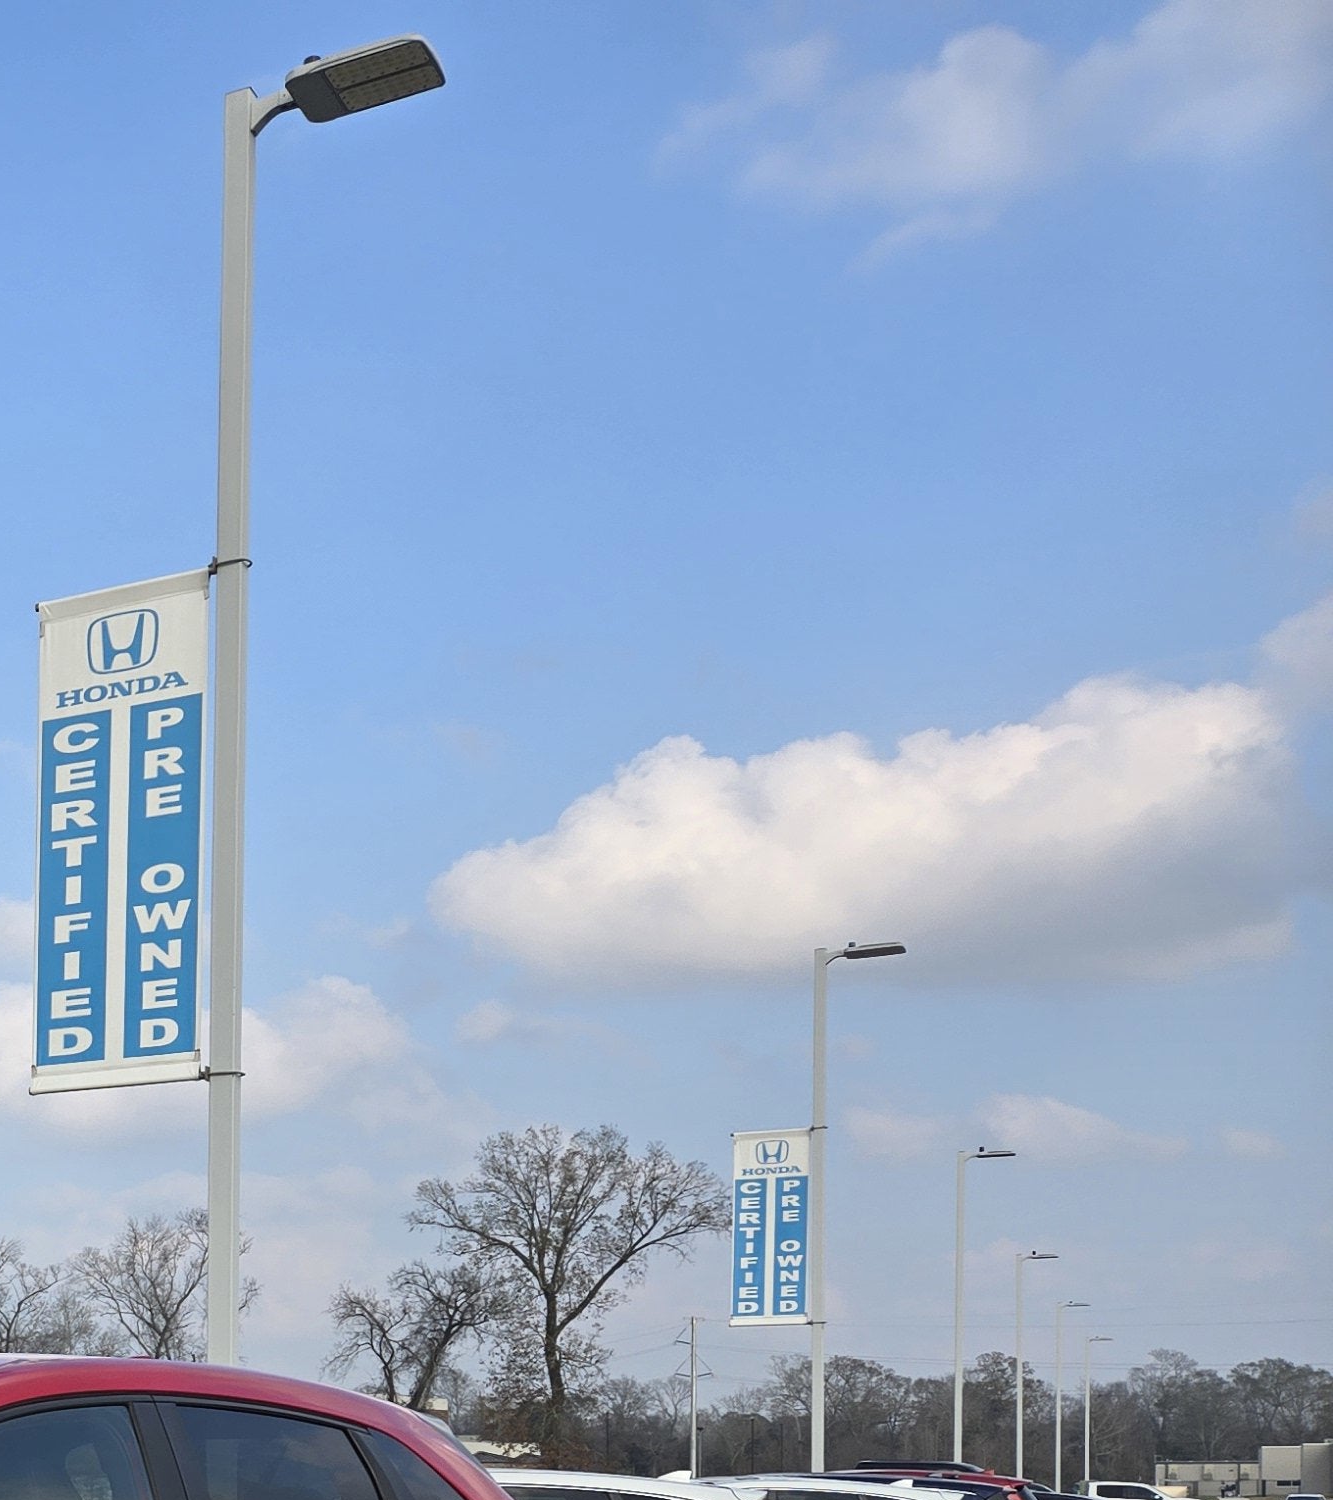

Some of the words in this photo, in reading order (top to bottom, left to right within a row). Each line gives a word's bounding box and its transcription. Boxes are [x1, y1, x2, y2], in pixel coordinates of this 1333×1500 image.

[56, 671, 188, 709] HONDA
[143, 707, 185, 818] PRE
[48, 722, 100, 1057] CERTIFIED
[132, 862, 192, 1050] OWNED
[741, 1166, 801, 1176] HONDA
[781, 1179, 801, 1223] PRE
[737, 1181, 762, 1314] CERTIFIED
[776, 1239, 804, 1313] OWNED
